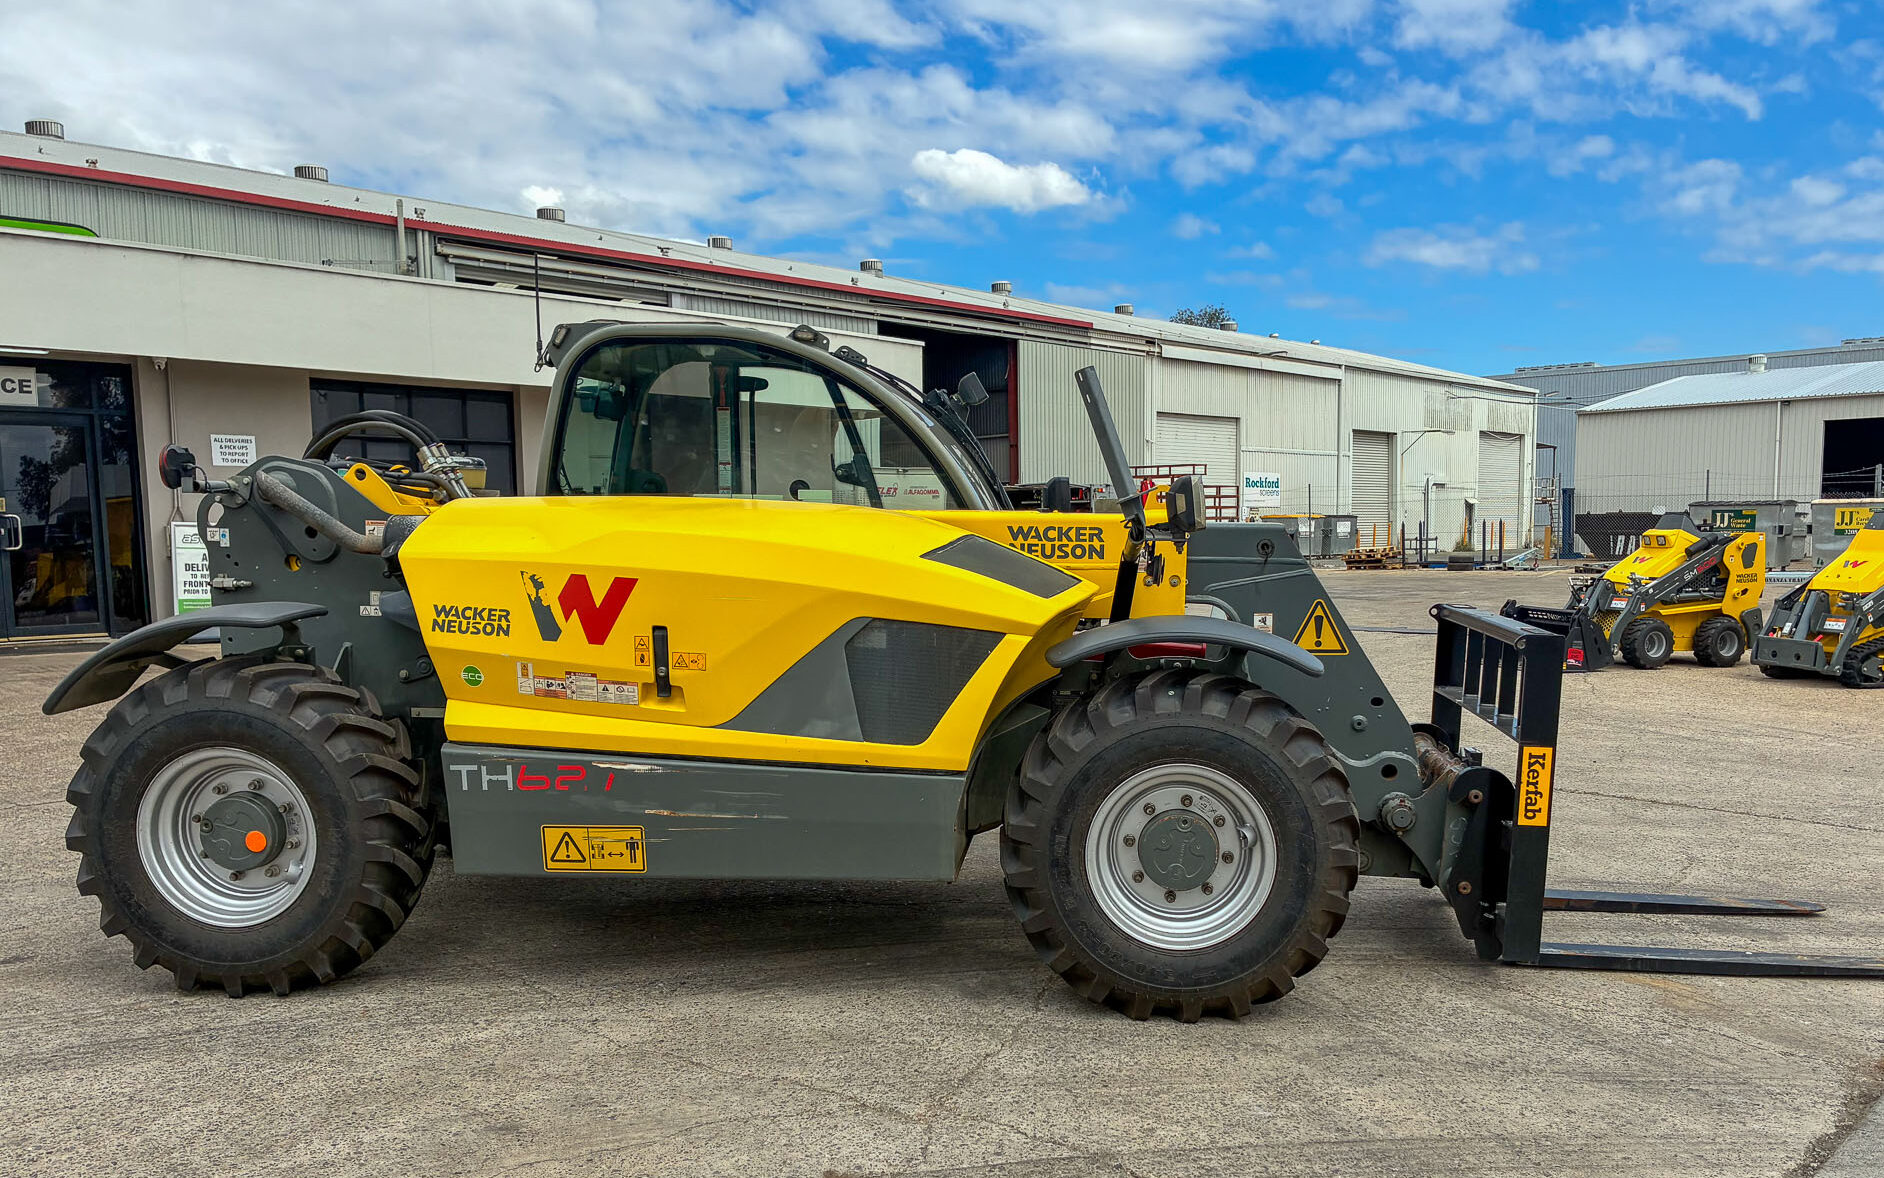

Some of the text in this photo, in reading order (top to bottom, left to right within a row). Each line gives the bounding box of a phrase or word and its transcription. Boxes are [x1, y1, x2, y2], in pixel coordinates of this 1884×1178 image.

[0, 378, 32, 394] CE
[1245, 477, 1279, 489] Rockford
[1007, 526, 1105, 543] WACKER
[433, 604, 511, 624] WACKER
[431, 619, 511, 637] NEUSON
[461, 672, 484, 681] ECO
[1523, 752, 1546, 820] Kerfab
